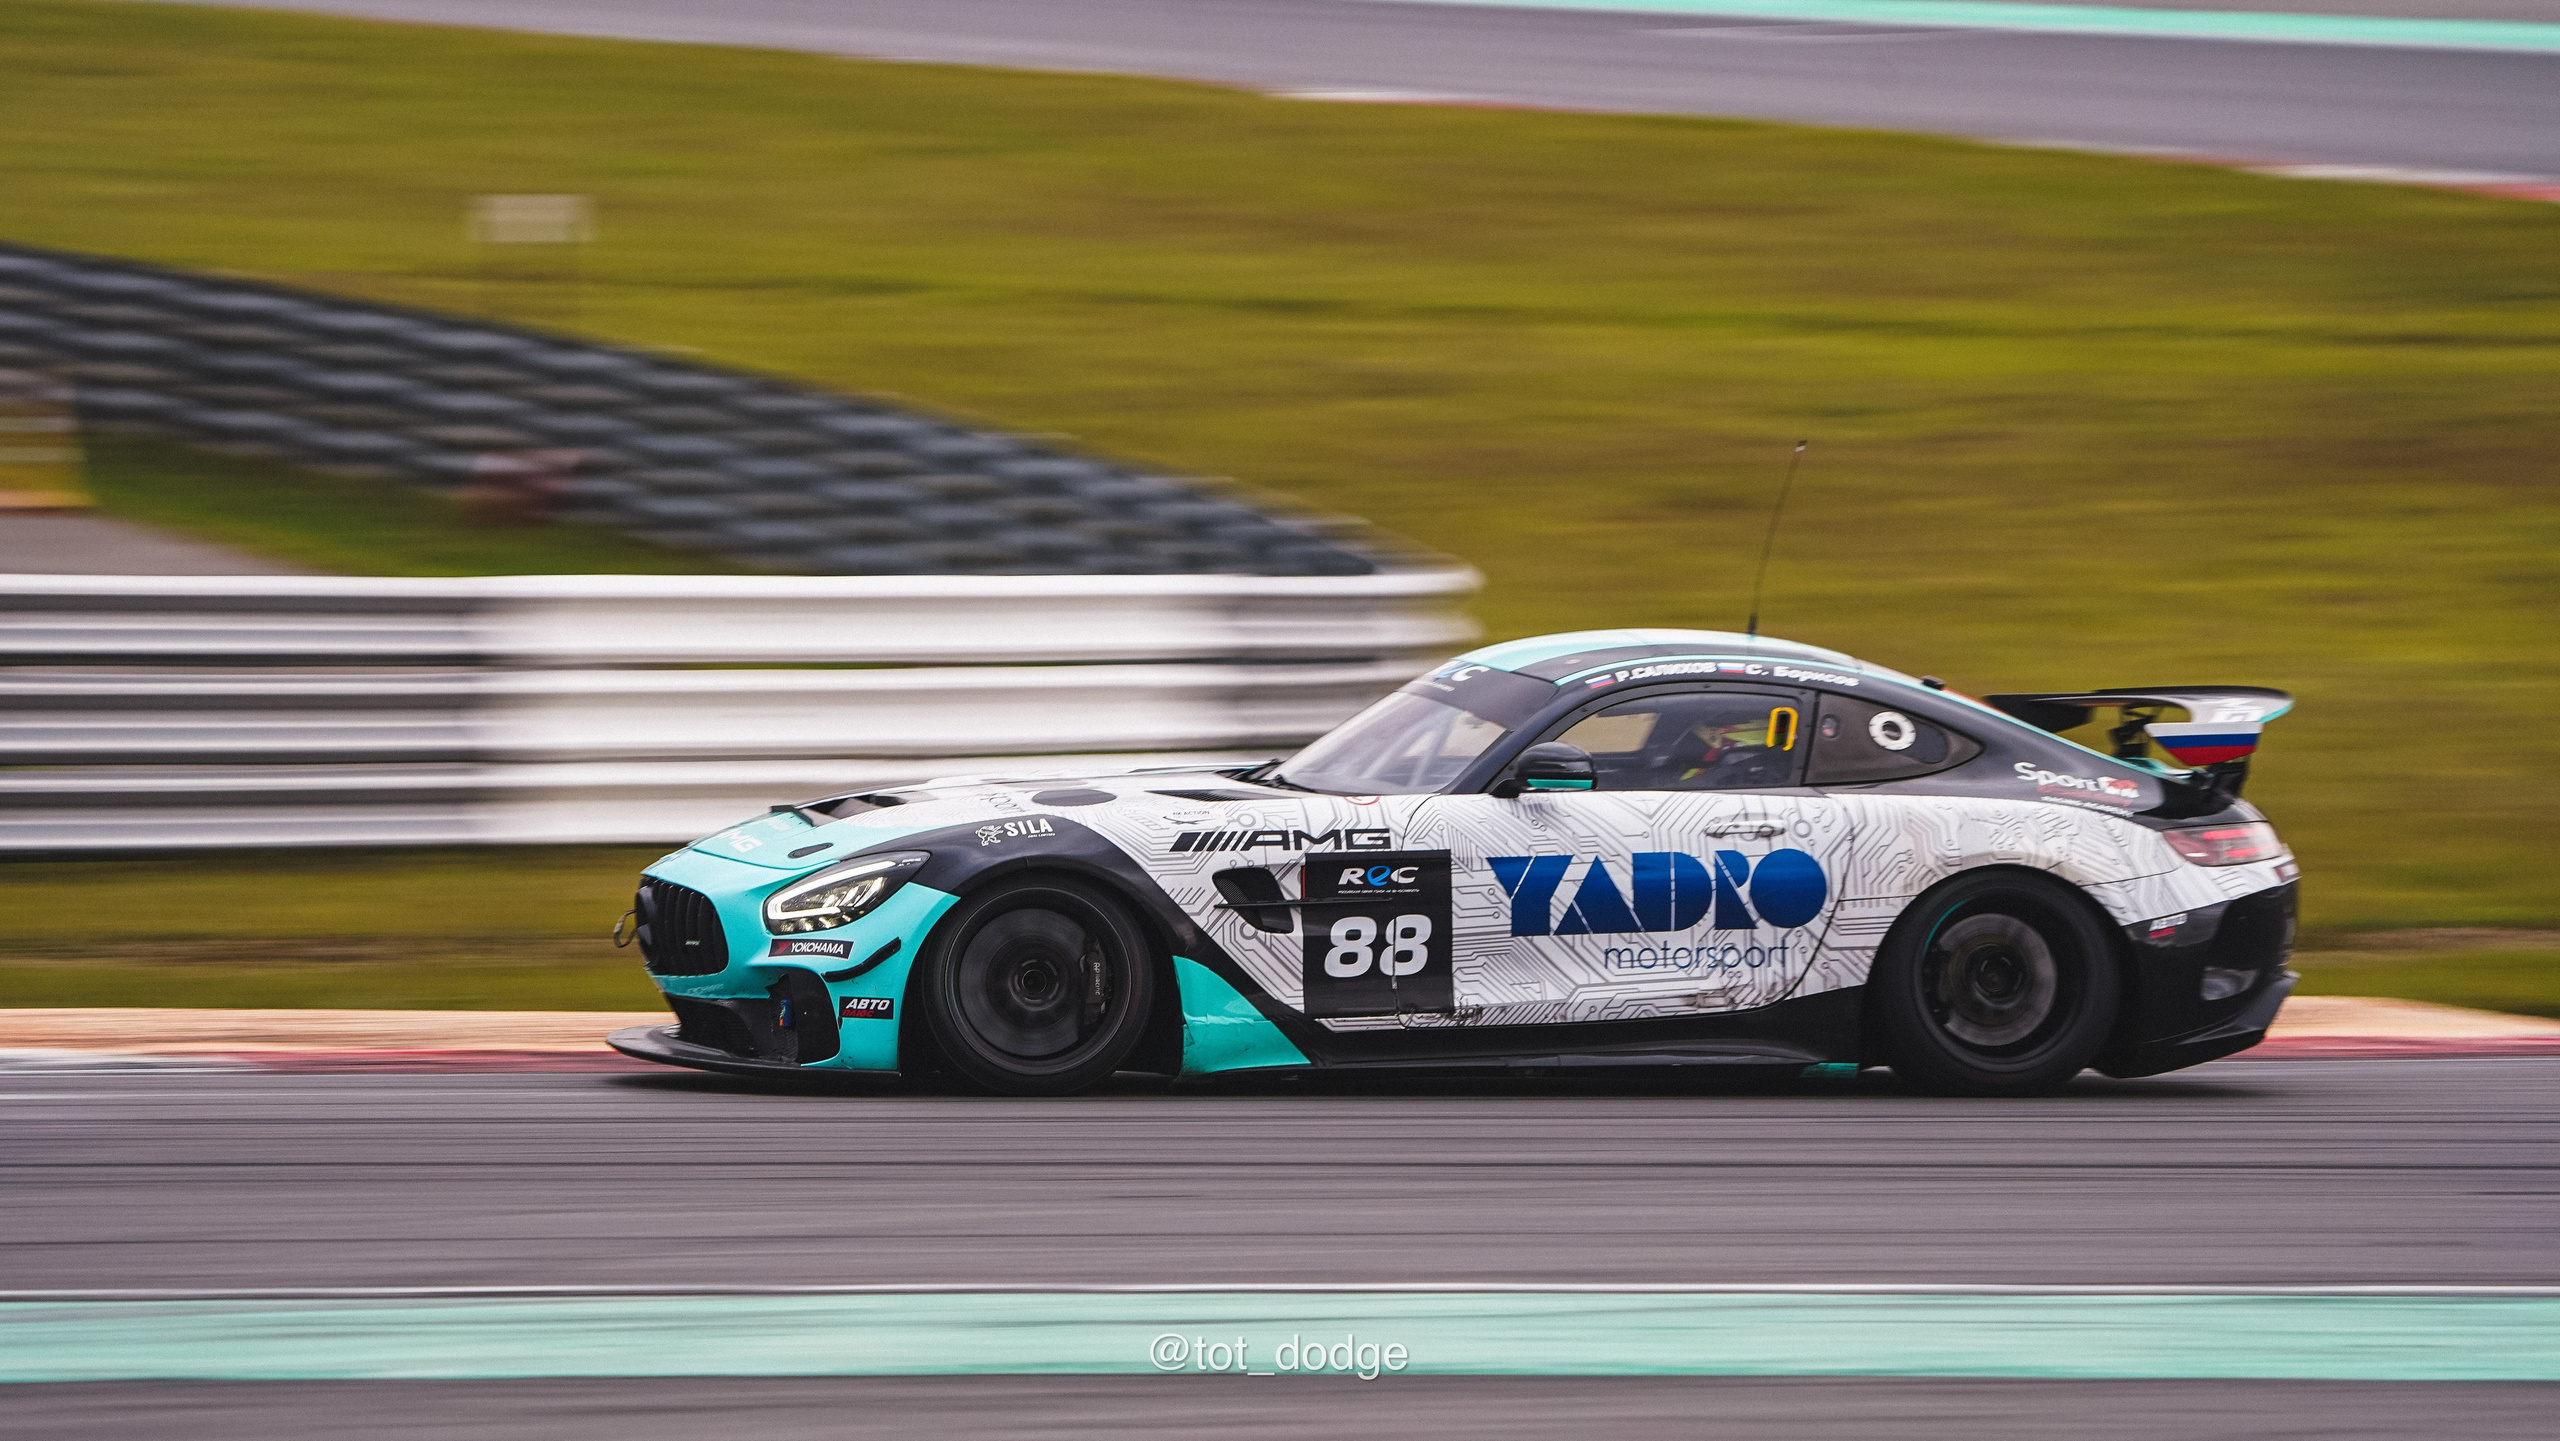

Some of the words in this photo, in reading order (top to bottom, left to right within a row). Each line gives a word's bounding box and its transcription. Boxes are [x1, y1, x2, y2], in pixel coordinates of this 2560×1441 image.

[1004, 818, 1053, 836] SILA
[1487, 848, 1827, 937] YADRO
[790, 942, 844, 954] YOKOHAMA
[1325, 914, 1433, 978] 88
[1604, 941, 1789, 975] motorsport
[846, 998, 890, 1010] АВТО
